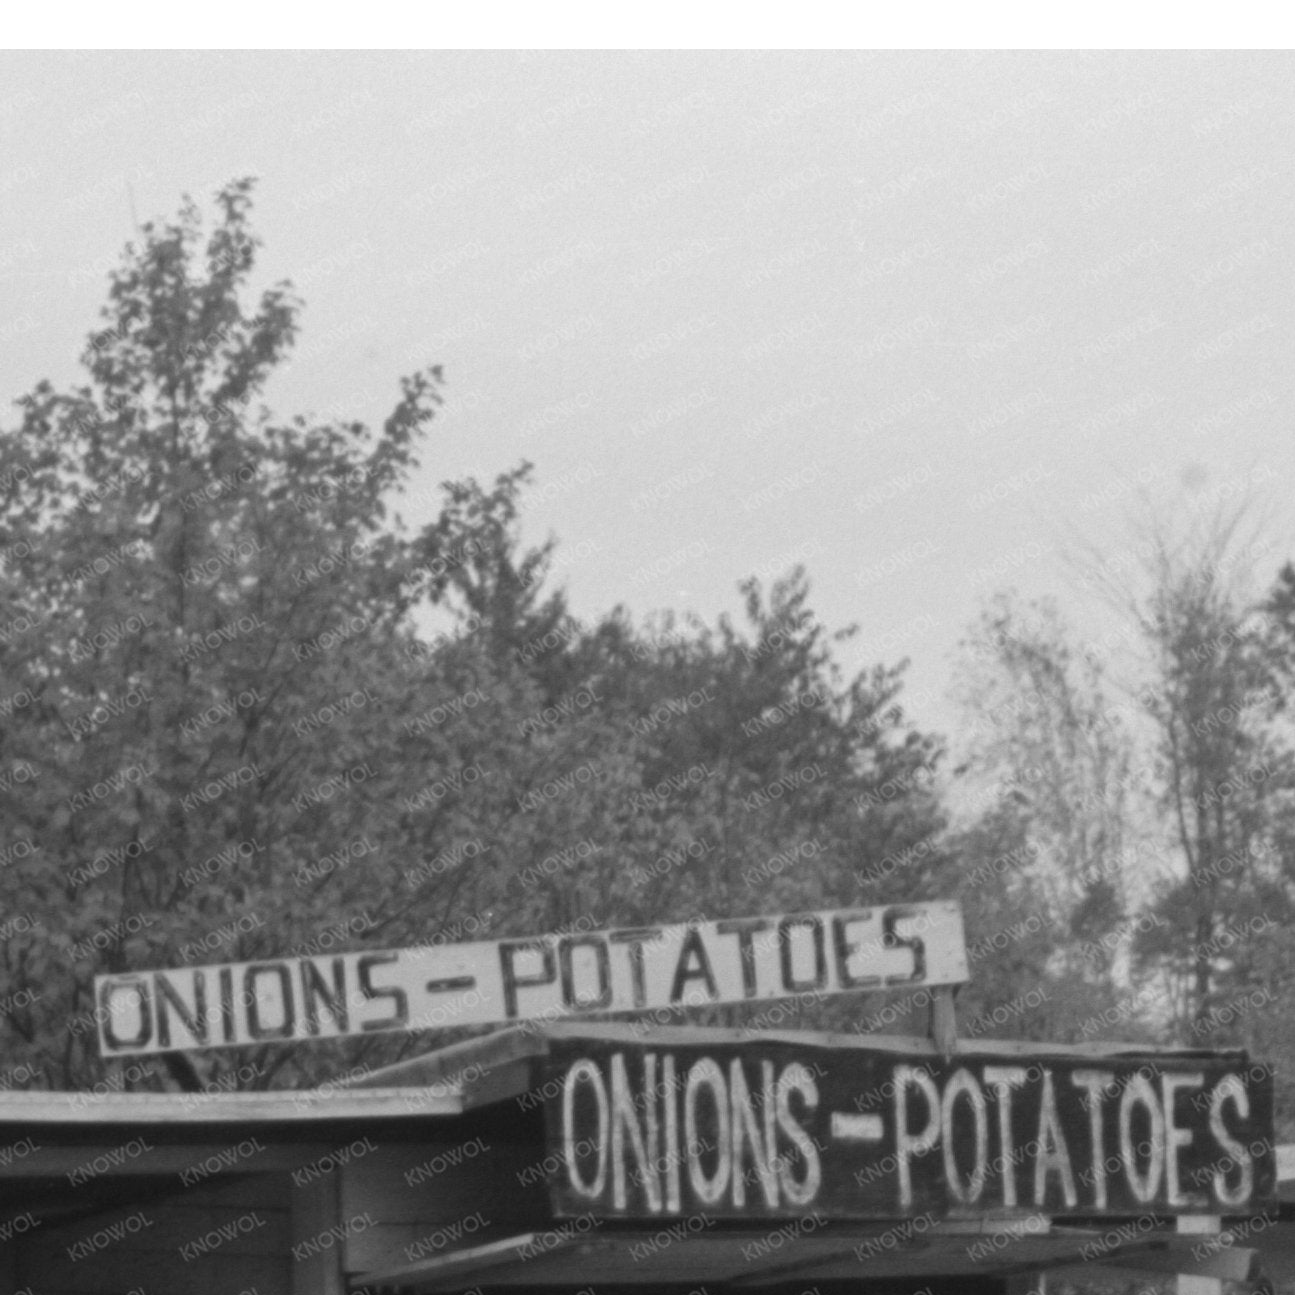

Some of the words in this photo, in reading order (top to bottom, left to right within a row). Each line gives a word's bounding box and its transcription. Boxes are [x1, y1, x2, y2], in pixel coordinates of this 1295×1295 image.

[103, 953, 408, 1051] ONIONS
[498, 907, 928, 1018] POTATOES
[563, 1052, 821, 1213] ONIONS
[893, 1064, 1254, 1209] POTATOES
